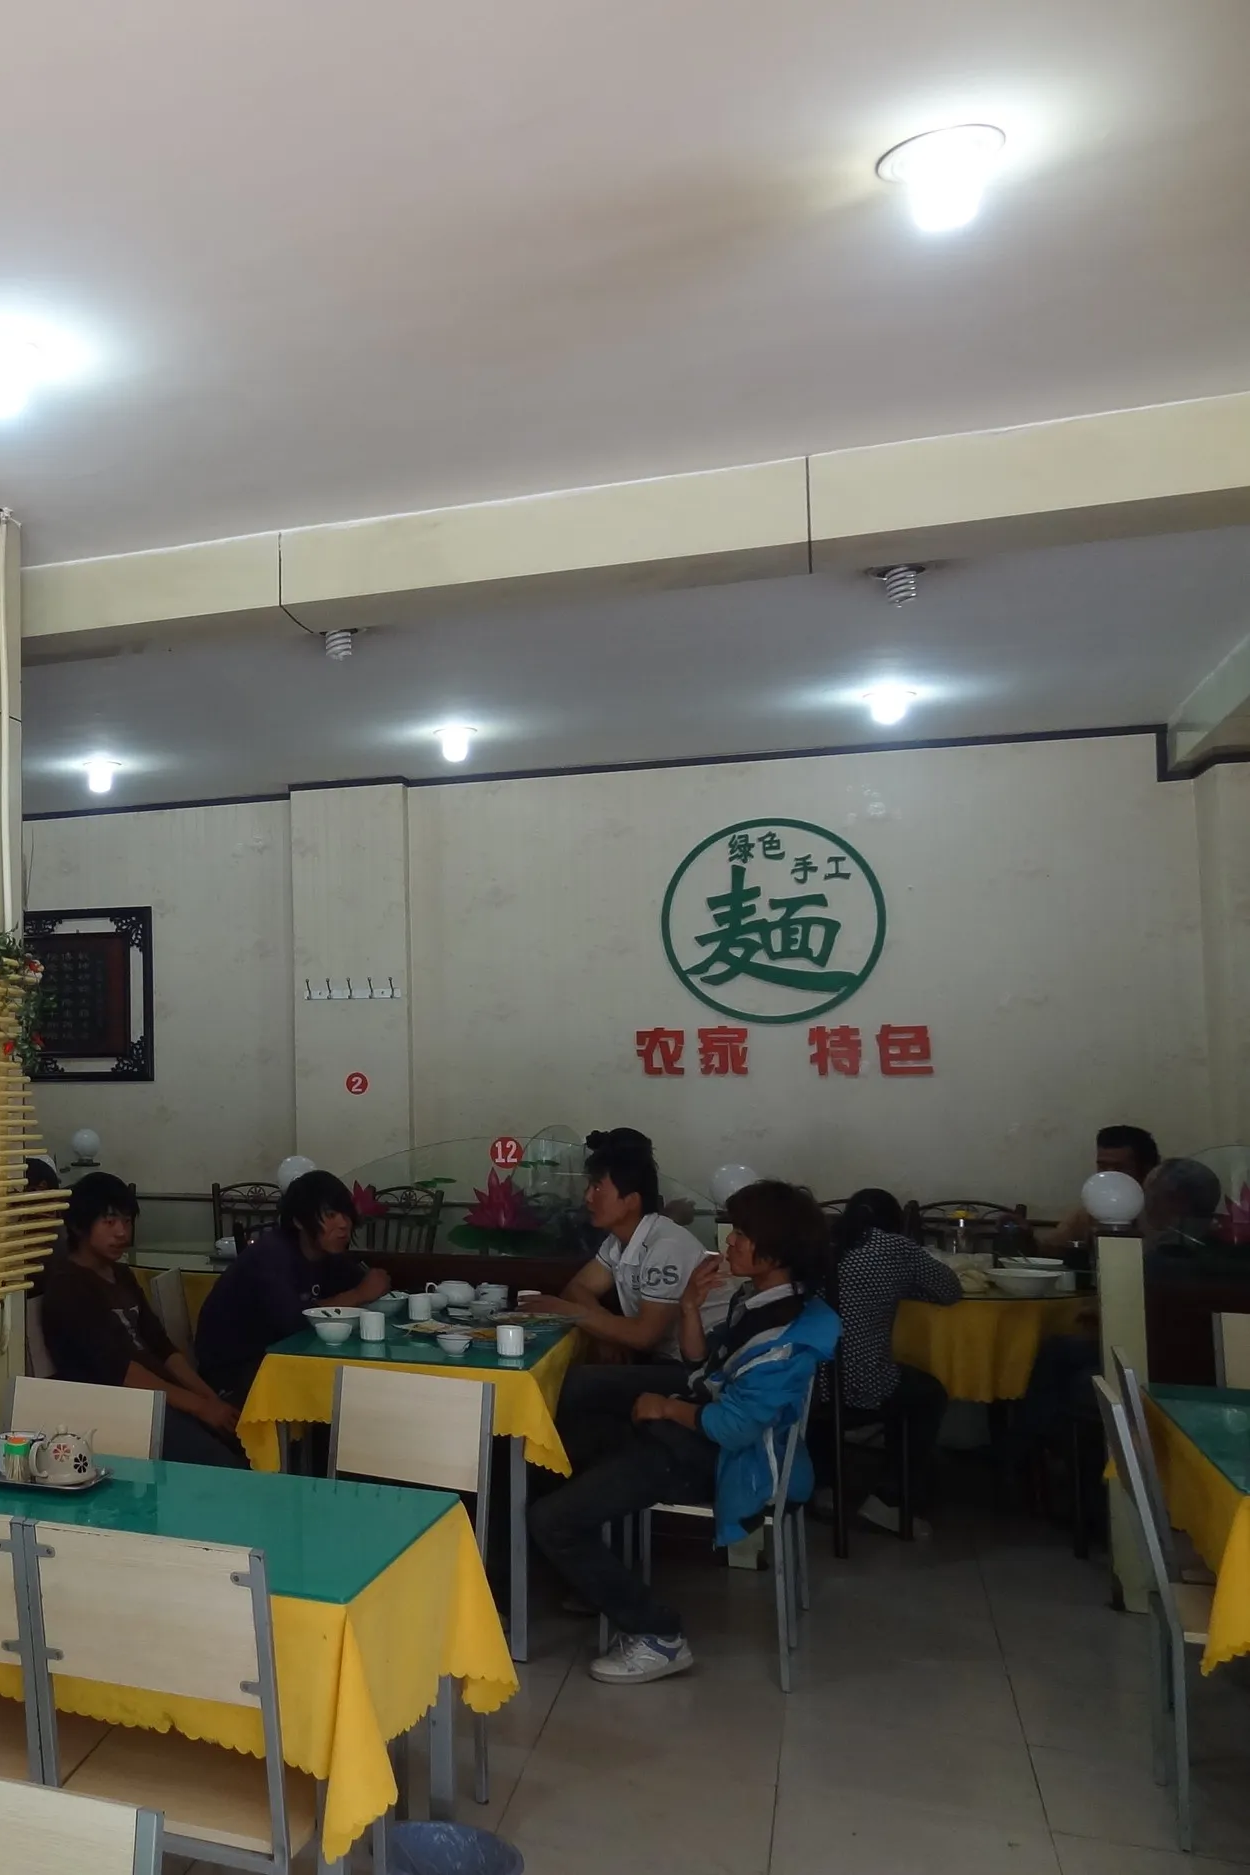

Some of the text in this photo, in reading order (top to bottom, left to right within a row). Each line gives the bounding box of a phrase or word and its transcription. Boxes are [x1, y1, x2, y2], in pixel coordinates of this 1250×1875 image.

[727, 831, 852, 884] 绿色 手工
[636, 1024, 934, 1078] 农家 特色
[351, 1076, 363, 1092] 2
[494, 1140, 518, 1163] 12
